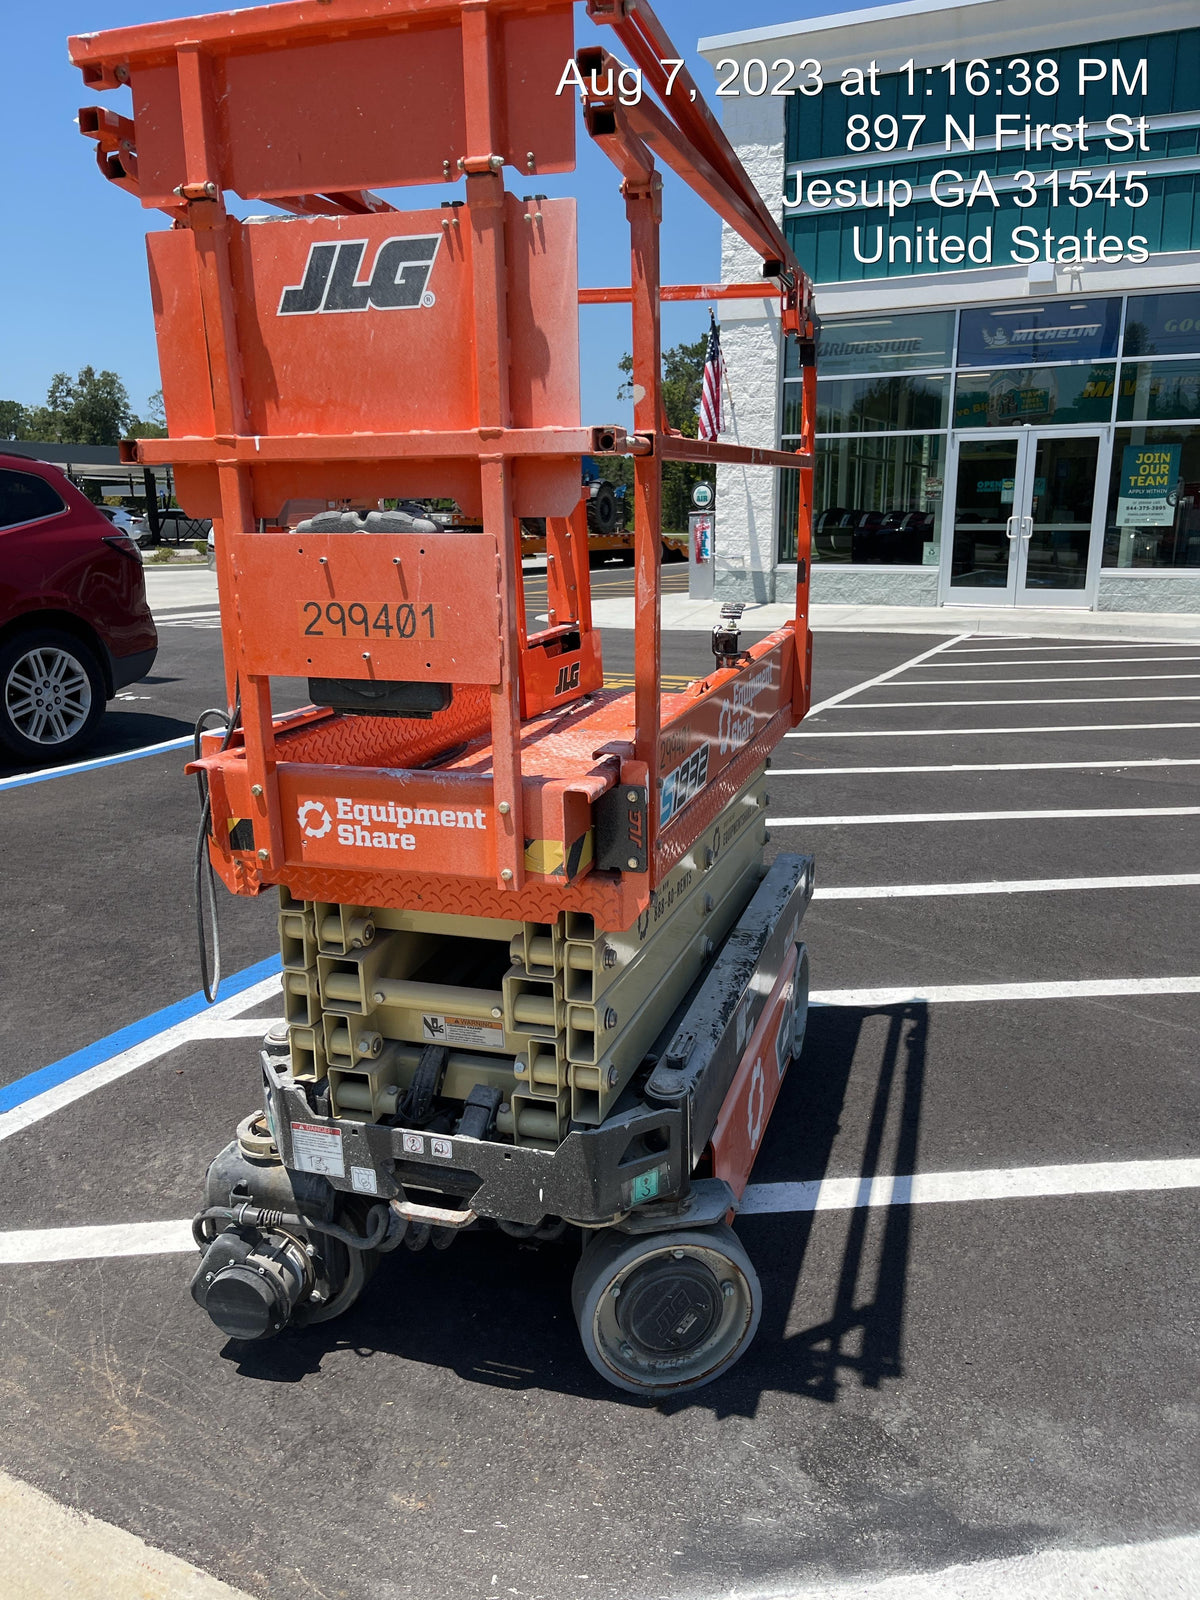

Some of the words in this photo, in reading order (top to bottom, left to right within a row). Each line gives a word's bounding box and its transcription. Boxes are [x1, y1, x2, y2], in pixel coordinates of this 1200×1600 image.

[277, 233, 442, 316] JLG
[817, 340, 922, 358] BRIDGESTONE
[1011, 326, 1098, 342] MICHELIN
[1136, 452, 1171, 464] JOIN
[1139, 464, 1170, 475] OUR
[1129, 475, 1168, 487] TEAM
[303, 601, 435, 638] 299401
[554, 660, 581, 698] JLG
[732, 662, 774, 716] Equipment
[730, 713, 756, 753] Share
[660, 741, 710, 828] S1932
[335, 797, 487, 830] Equipment
[628, 809, 643, 848] JLG
[337, 823, 417, 851] Share
[461, 1018, 493, 1028] WARNING
[305, 1124, 333, 1134] DANGER
